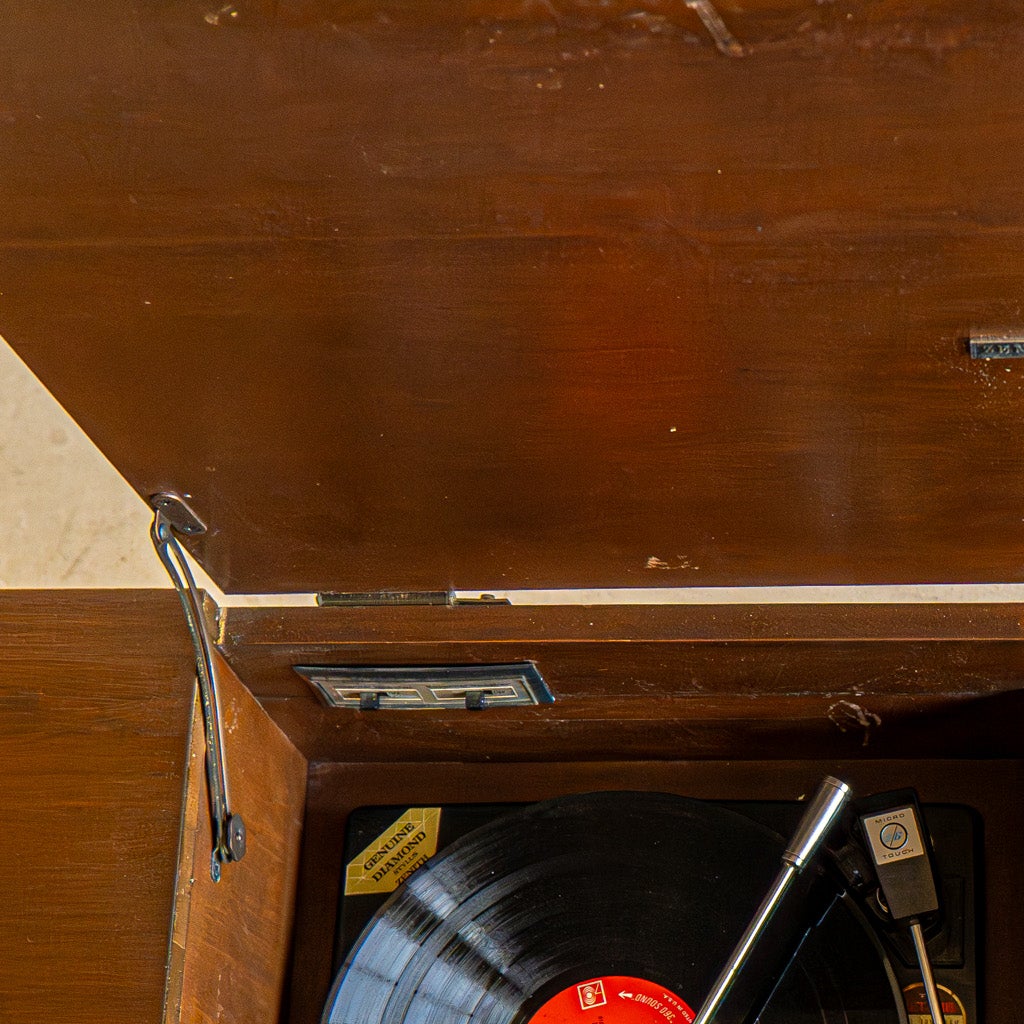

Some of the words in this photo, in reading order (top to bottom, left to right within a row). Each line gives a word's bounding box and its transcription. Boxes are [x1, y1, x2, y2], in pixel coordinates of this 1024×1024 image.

[875, 813, 906, 824] MICRO
[364, 822, 415, 871] GENUINE
[372, 831, 426, 882] DIAMOND
[883, 848, 914, 860] TOUCH
[393, 852, 418, 875] STYLUS
